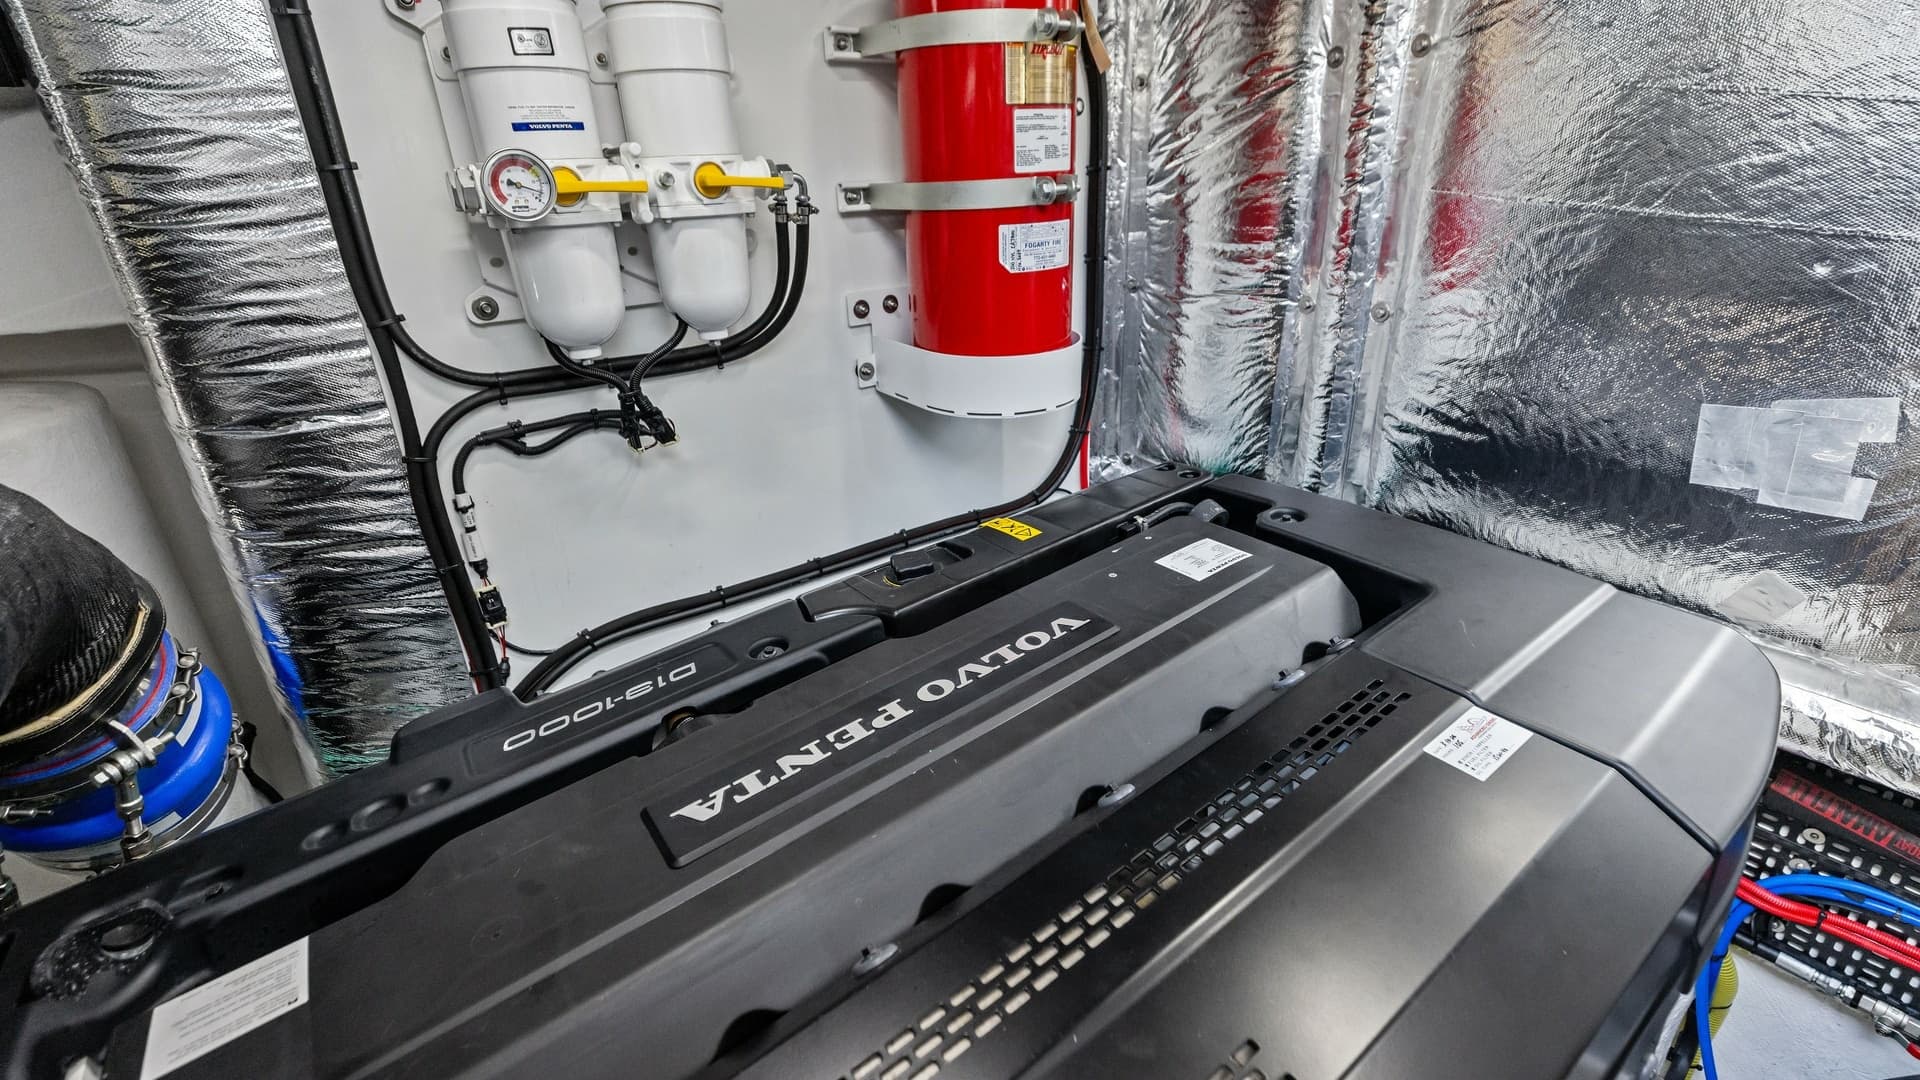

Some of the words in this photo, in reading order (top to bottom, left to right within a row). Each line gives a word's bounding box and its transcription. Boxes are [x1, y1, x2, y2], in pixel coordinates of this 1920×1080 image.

[1024, 240, 1050, 249] FOGARTY
[916, 617, 1091, 702] VOLVO
[503, 662, 696, 751] D13-1000
[669, 698, 914, 822] PENTA
